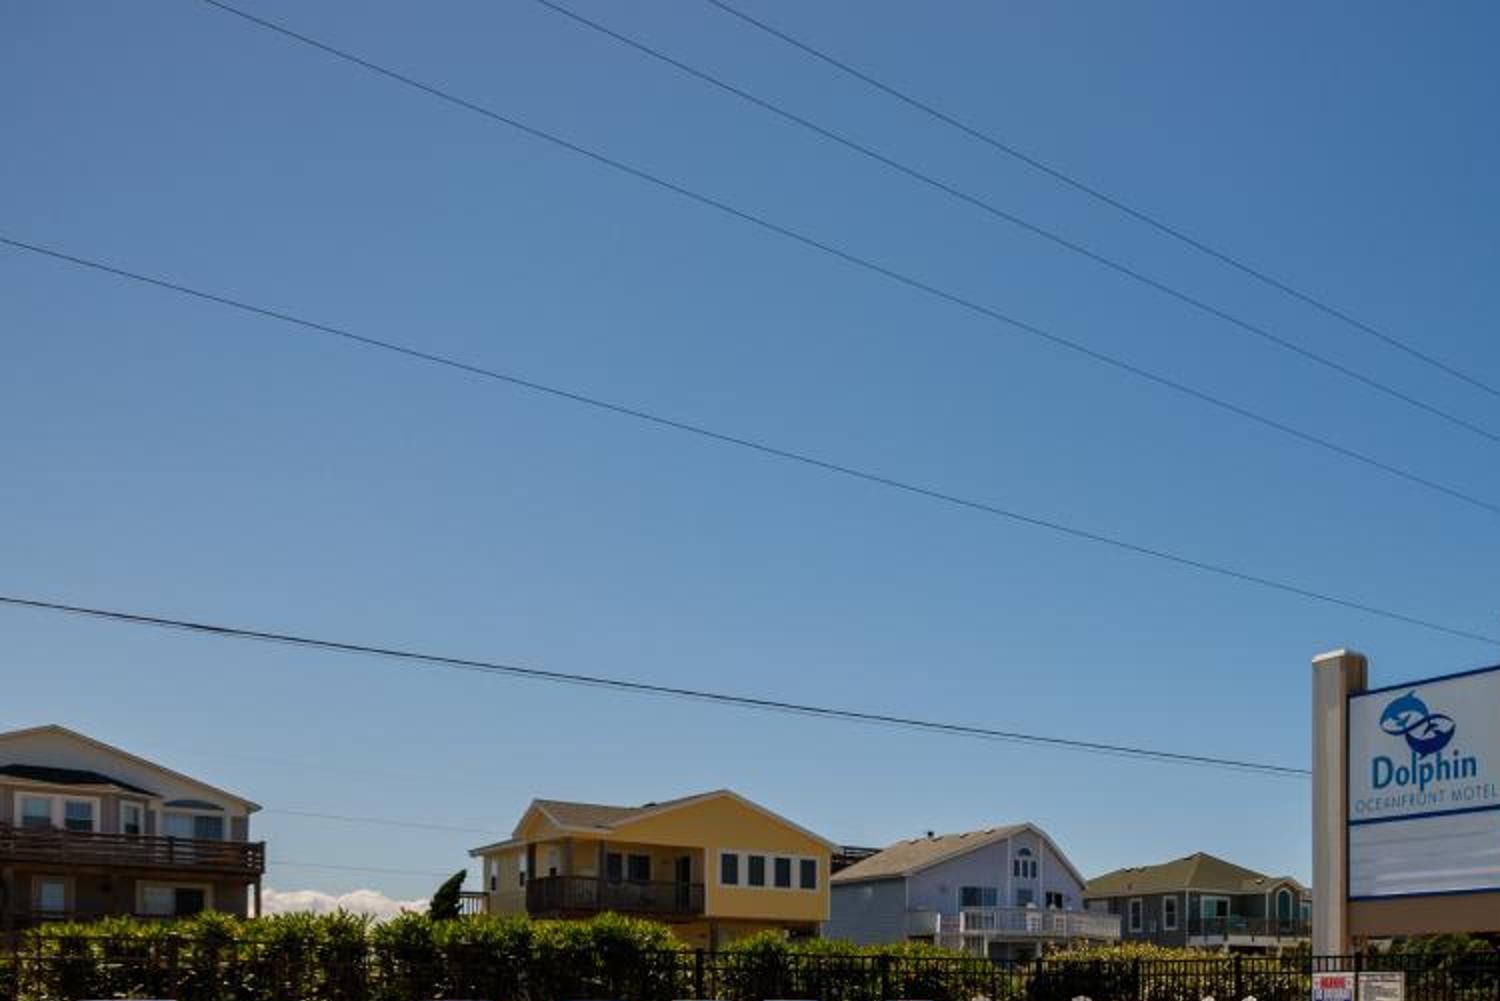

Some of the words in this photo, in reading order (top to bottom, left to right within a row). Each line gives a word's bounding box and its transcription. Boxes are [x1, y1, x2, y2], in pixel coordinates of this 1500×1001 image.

[1372, 749, 1477, 791] Dolphin
[1355, 789, 1446, 813] OCEANFRONT
[1452, 783, 1498, 801] MOTEL
